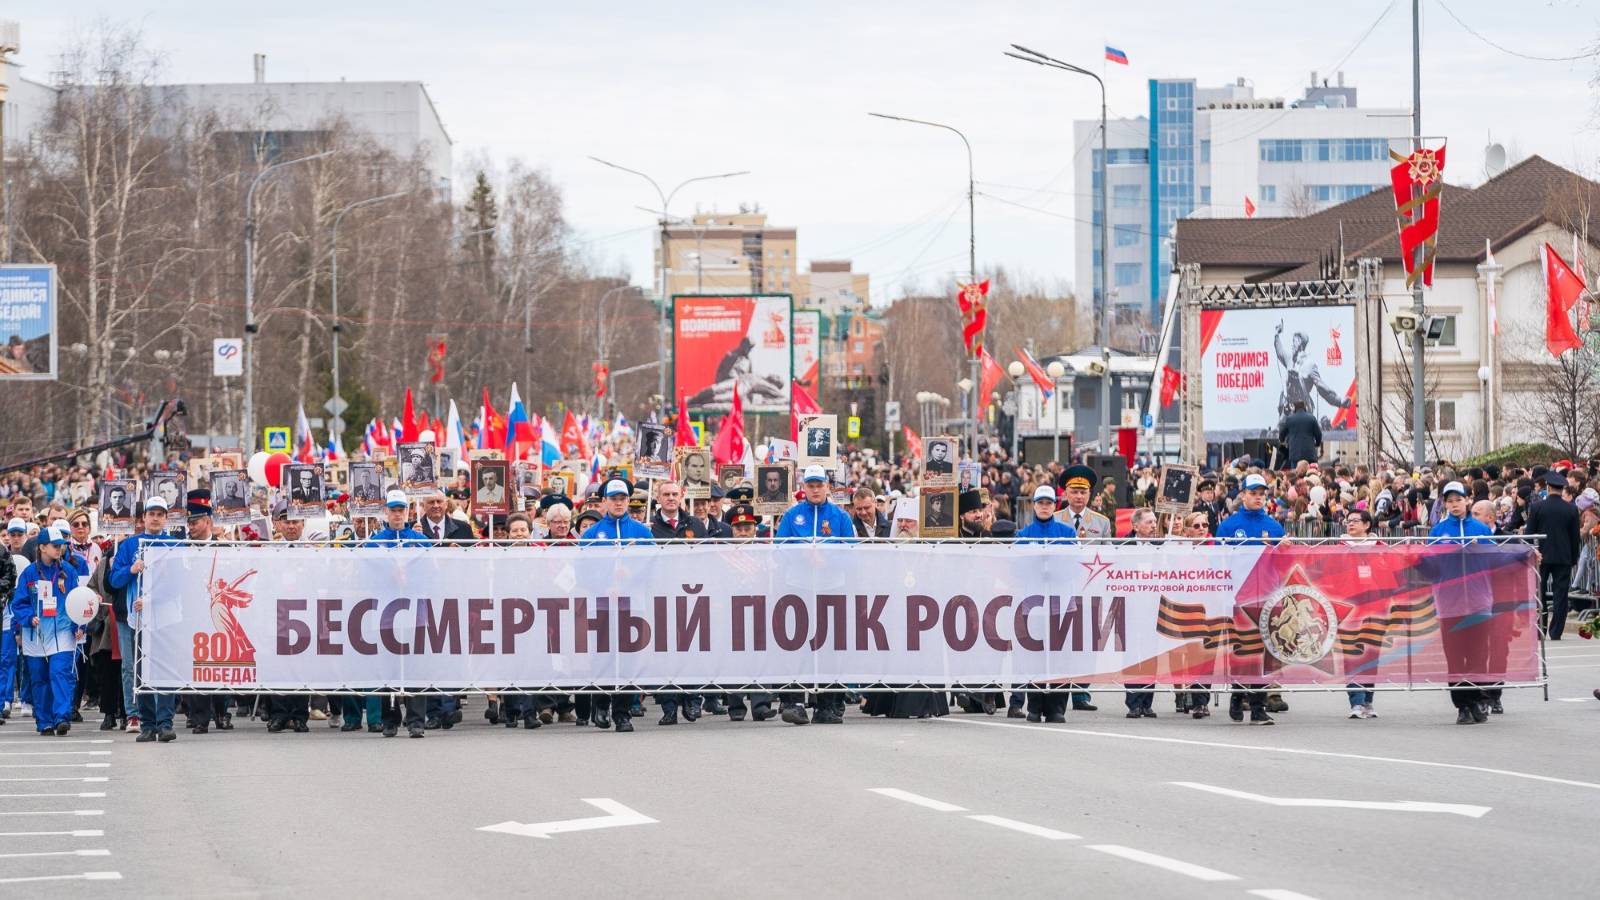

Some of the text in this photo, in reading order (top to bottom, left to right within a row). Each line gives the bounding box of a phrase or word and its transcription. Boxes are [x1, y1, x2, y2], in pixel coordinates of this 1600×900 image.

[1216, 351, 1268, 369] ГОРДИМСЯ
[1216, 371, 1264, 390] ПОБЕДОЙ!
[1106, 568, 1232, 580] ХАНТЫ-МАНСИЙСК
[1138, 584, 1184, 592] ТРУДОВОЙ
[276, 584, 1126, 655] БЕССМЕРТНЫЙ ПОЛК РОССИИ
[193, 631, 227, 661] 80
[193, 667, 256, 685] ПОБЕДА!
